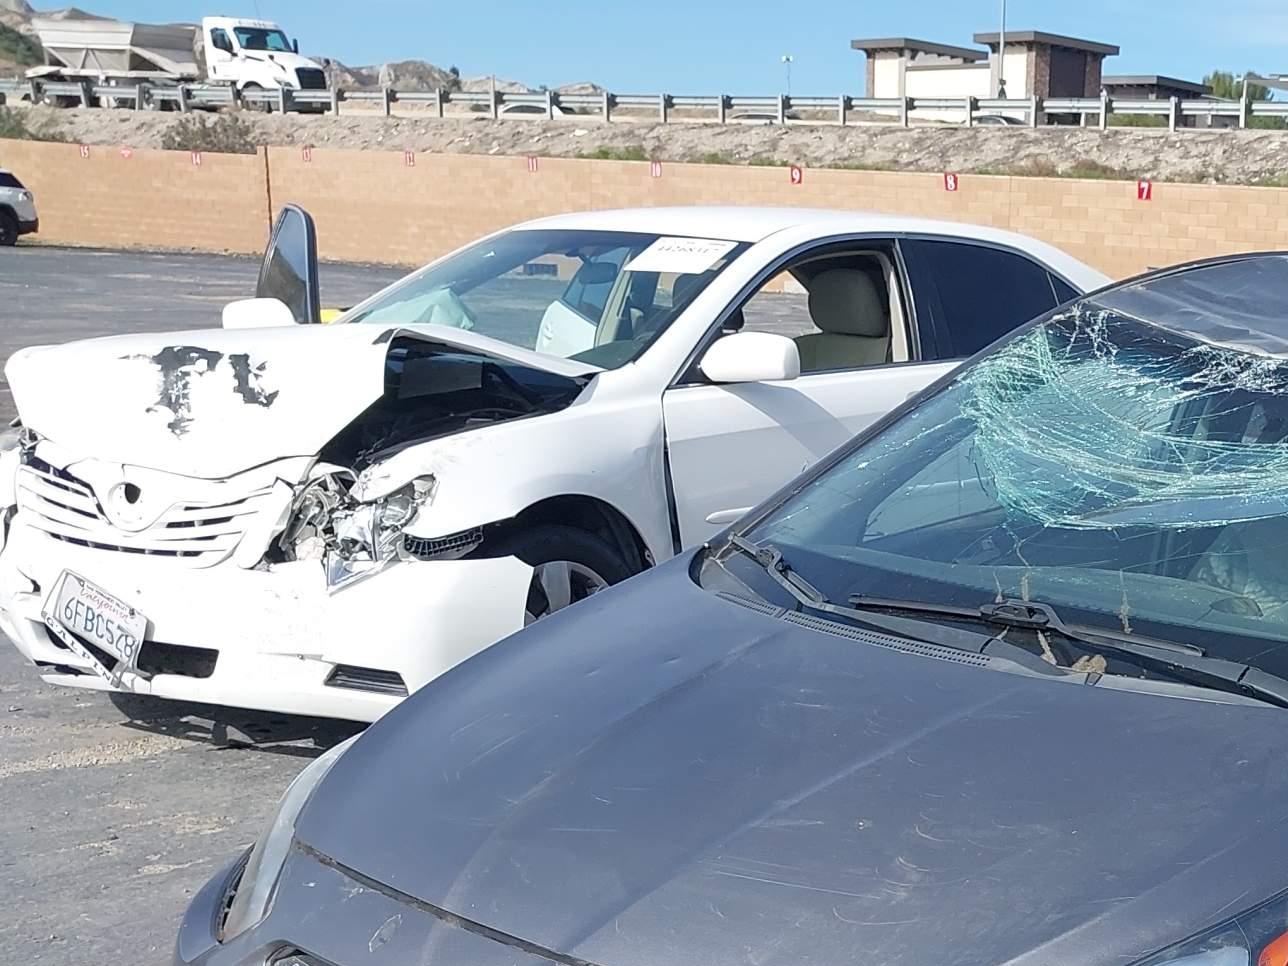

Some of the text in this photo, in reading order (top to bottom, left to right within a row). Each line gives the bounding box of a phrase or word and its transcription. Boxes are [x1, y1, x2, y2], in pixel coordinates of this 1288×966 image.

[80, 145, 89, 158] 15
[793, 170, 801, 183] 9
[946, 175, 956, 191] 8
[1141, 182, 1149, 200] 7
